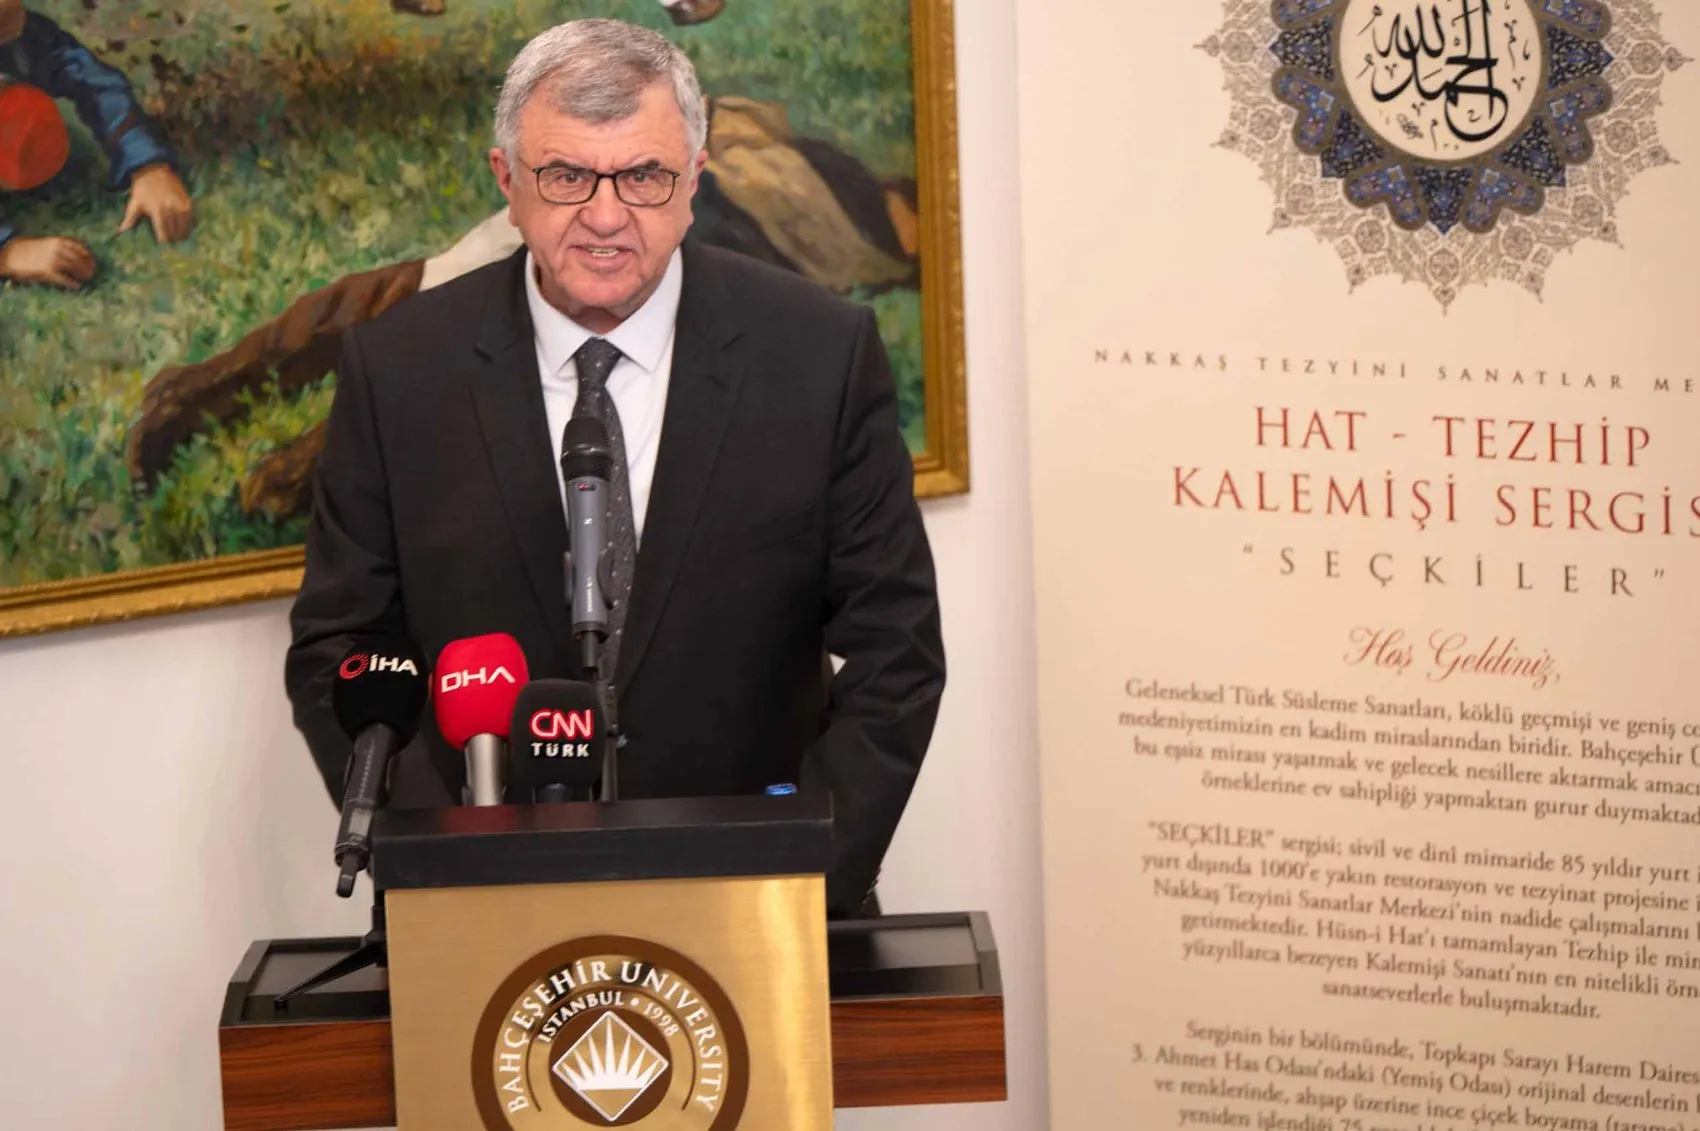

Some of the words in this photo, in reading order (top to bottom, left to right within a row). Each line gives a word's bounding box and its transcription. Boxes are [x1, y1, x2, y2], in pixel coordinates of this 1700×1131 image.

[1095, 349, 1227, 372] NAKKAŞ
[1438, 366, 1623, 390] SANATLAR
[1255, 406, 1368, 452] HAT
[1432, 416, 1651, 467] TEZHİP
[1173, 466, 1457, 531] KALEMİŞİ
[369, 654, 418, 676] İHA
[441, 666, 516, 693] DHA
[1343, 627, 1413, 675] Hoş
[1426, 629, 1561, 688] Geldiniz,
[530, 709, 593, 739] CNN
[1125, 679, 1224, 703] Geleneksel
[1230, 686, 1276, 707] Türk
[1283, 690, 1358, 713] Süsleme
[1460, 701, 1514, 724] köklü
[1521, 711, 1592, 734] geçmişi
[1599, 719, 1620, 732] ve
[1626, 717, 1676, 740] geniş
[531, 743, 590, 758] TÜRK
[1119, 709, 1273, 736] medeniyetimizin
[1280, 725, 1301, 738] en
[1308, 719, 1366, 743] kadim
[1374, 727, 1501, 752] miraslarından
[1509, 733, 1572, 757] biridir.
[1581, 739, 1684, 767] Bahçeşehir
[1134, 735, 1158, 755] bu
[1211, 745, 1266, 763] mirası
[1272, 750, 1357, 771] yaşatmak
[1364, 759, 1384, 773] ve
[1391, 755, 1459, 780] gelecek
[1466, 761, 1542, 784] nesillere
[1549, 766, 1638, 791] aktarmak
[1201, 771, 1306, 795] örneklerine
[1312, 784, 1332, 796] ev
[1339, 780, 1416, 809] sahipliği
[1424, 789, 1527, 812] yapmaktan
[1534, 800, 1589, 819] gurur
[1142, 853, 1180, 873] yurt
[1186, 852, 1252, 877] dışında
[1326, 864, 1376, 887] yakın
[1384, 874, 1487, 898] restorasyon
[1494, 883, 1515, 897] ve
[1522, 883, 1596, 905] tezyinat
[1604, 889, 1689, 912] projesine
[1349, 838, 1385, 858] sivil
[1393, 847, 1413, 860] ve
[1464, 849, 1555, 871] mimaride
[1562, 854, 1585, 875] 85
[1592, 856, 1644, 880] yıldır
[1649, 867, 1689, 885] yurt
[1154, 878, 1220, 905] Nakkaş
[1225, 882, 1291, 910] Tezyini
[1299, 890, 1373, 913] Sanatlar
[1500, 907, 1562, 929] nadide
[1569, 912, 1689, 940] çalışmalarını
[1184, 939, 1280, 962] yüzyıllarca
[1287, 944, 1358, 972] bezeyen
[1367, 952, 1446, 980] Kalemişi
[1554, 974, 1576, 988] en
[1584, 972, 1659, 995] nitelikli
[1443, 934, 1557, 961] tamamlayan
[1563, 940, 1629, 970] Tezhip
[1635, 945, 1658, 966] ile
[643, 1003, 679, 1037] 1998
[1322, 983, 1453, 1006] sanatseverlerle
[1460, 987, 1600, 1018] buluşmaktadır.
[499, 960, 612, 1114] BAHÇEŞEHİR
[620, 960, 723, 1112] UNIVERSITY
[1187, 1020, 1262, 1047] Serginin
[1269, 1027, 1294, 1047] bir
[1420, 1041, 1495, 1071] Topkapı
[1504, 1048, 1558, 1076] Sarayı
[1567, 1054, 1631, 1078] Harem
[1155, 1046, 1216, 1068] Ahmet
[1225, 1051, 1260, 1072] Has
[1518, 1081, 1585, 1105] orijinal
[1592, 1085, 1688, 1112] desenlerin
[1155, 1080, 1174, 1091] ve
[1296, 1086, 1348, 1114] ahşap
[1353, 1093, 1420, 1115] üzerine
[1427, 1100, 1464, 1120] ince
[1471, 1105, 1518, 1127] çiçek
[1525, 1106, 1599, 1131] boyama
[1178, 1107, 1250, 1128] yeniden
